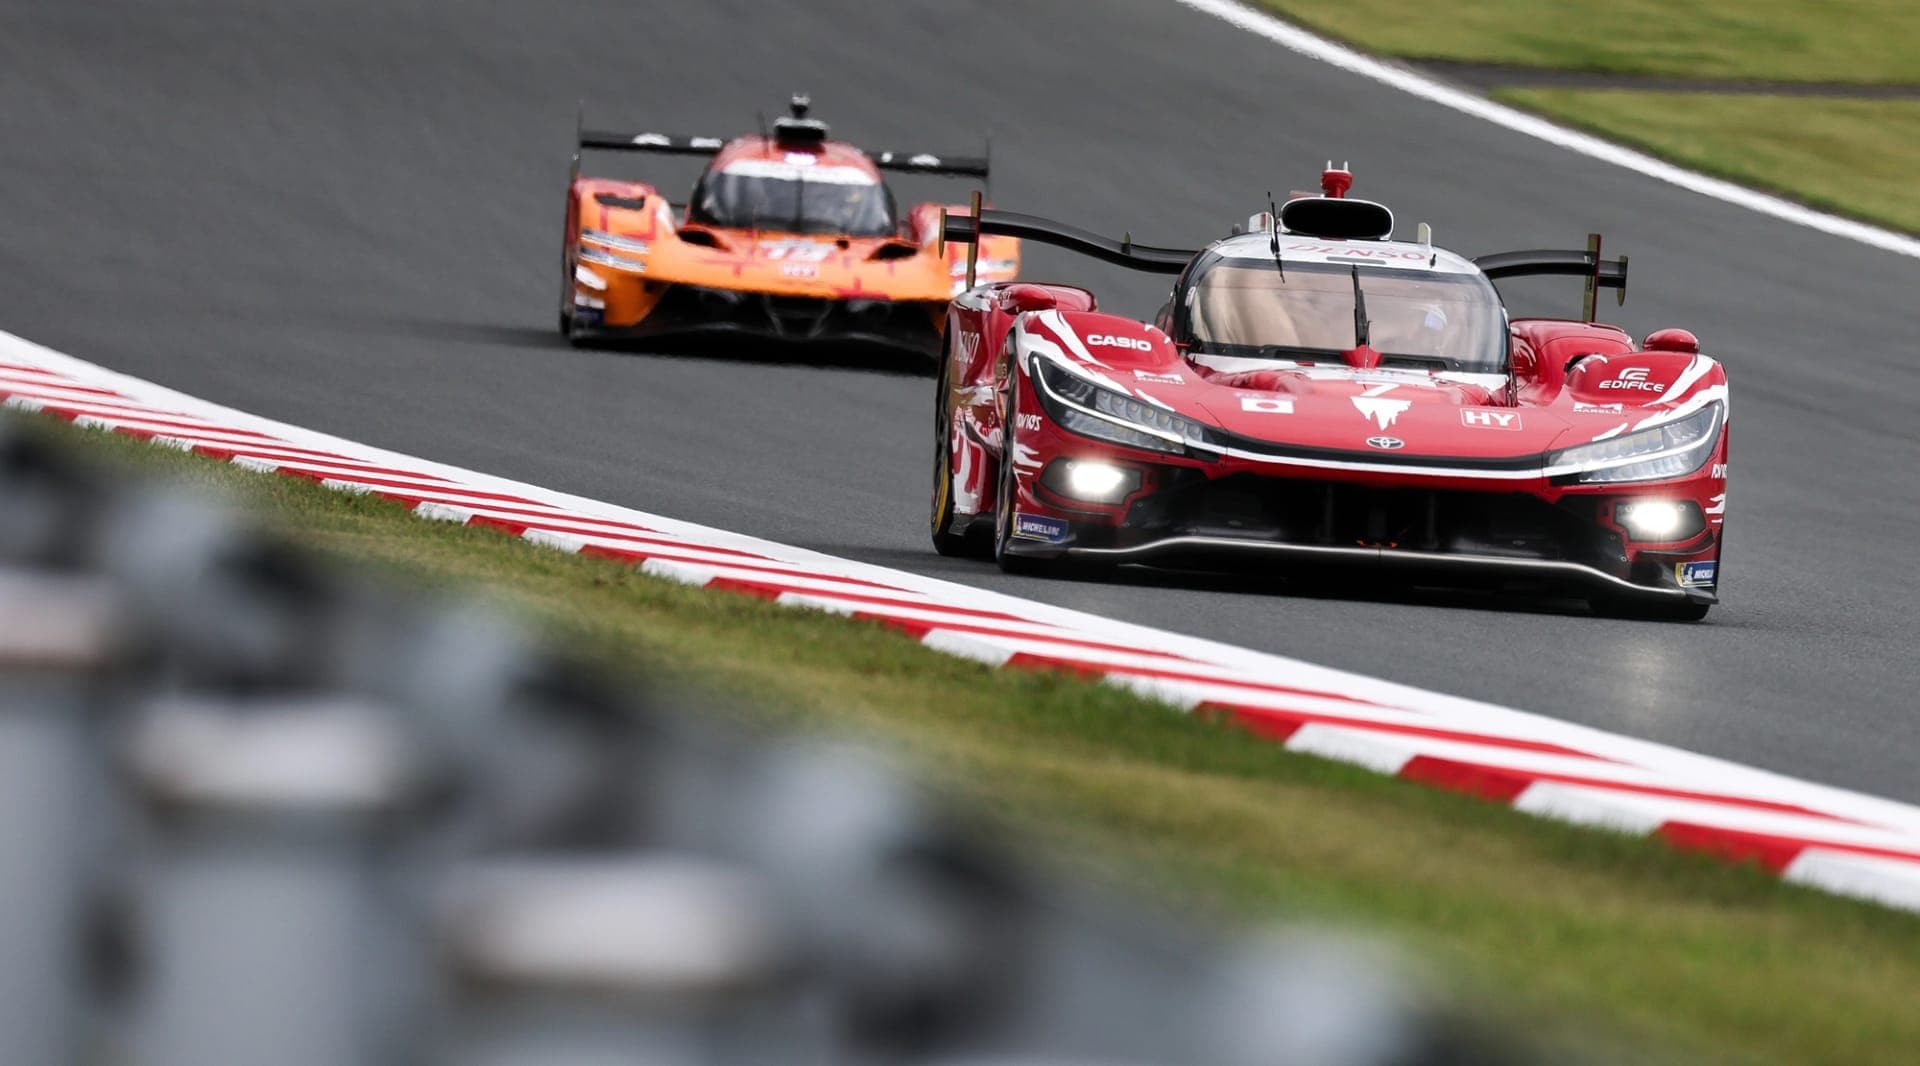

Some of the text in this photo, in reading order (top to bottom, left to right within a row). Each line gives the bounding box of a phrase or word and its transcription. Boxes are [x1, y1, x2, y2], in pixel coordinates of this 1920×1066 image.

[1286, 244, 1425, 261] DENSO
[1086, 334, 1152, 351] CASIO
[1355, 381, 1400, 397] 7
[1598, 380, 1665, 393] EDIFICE
[1465, 411, 1515, 426] HY
